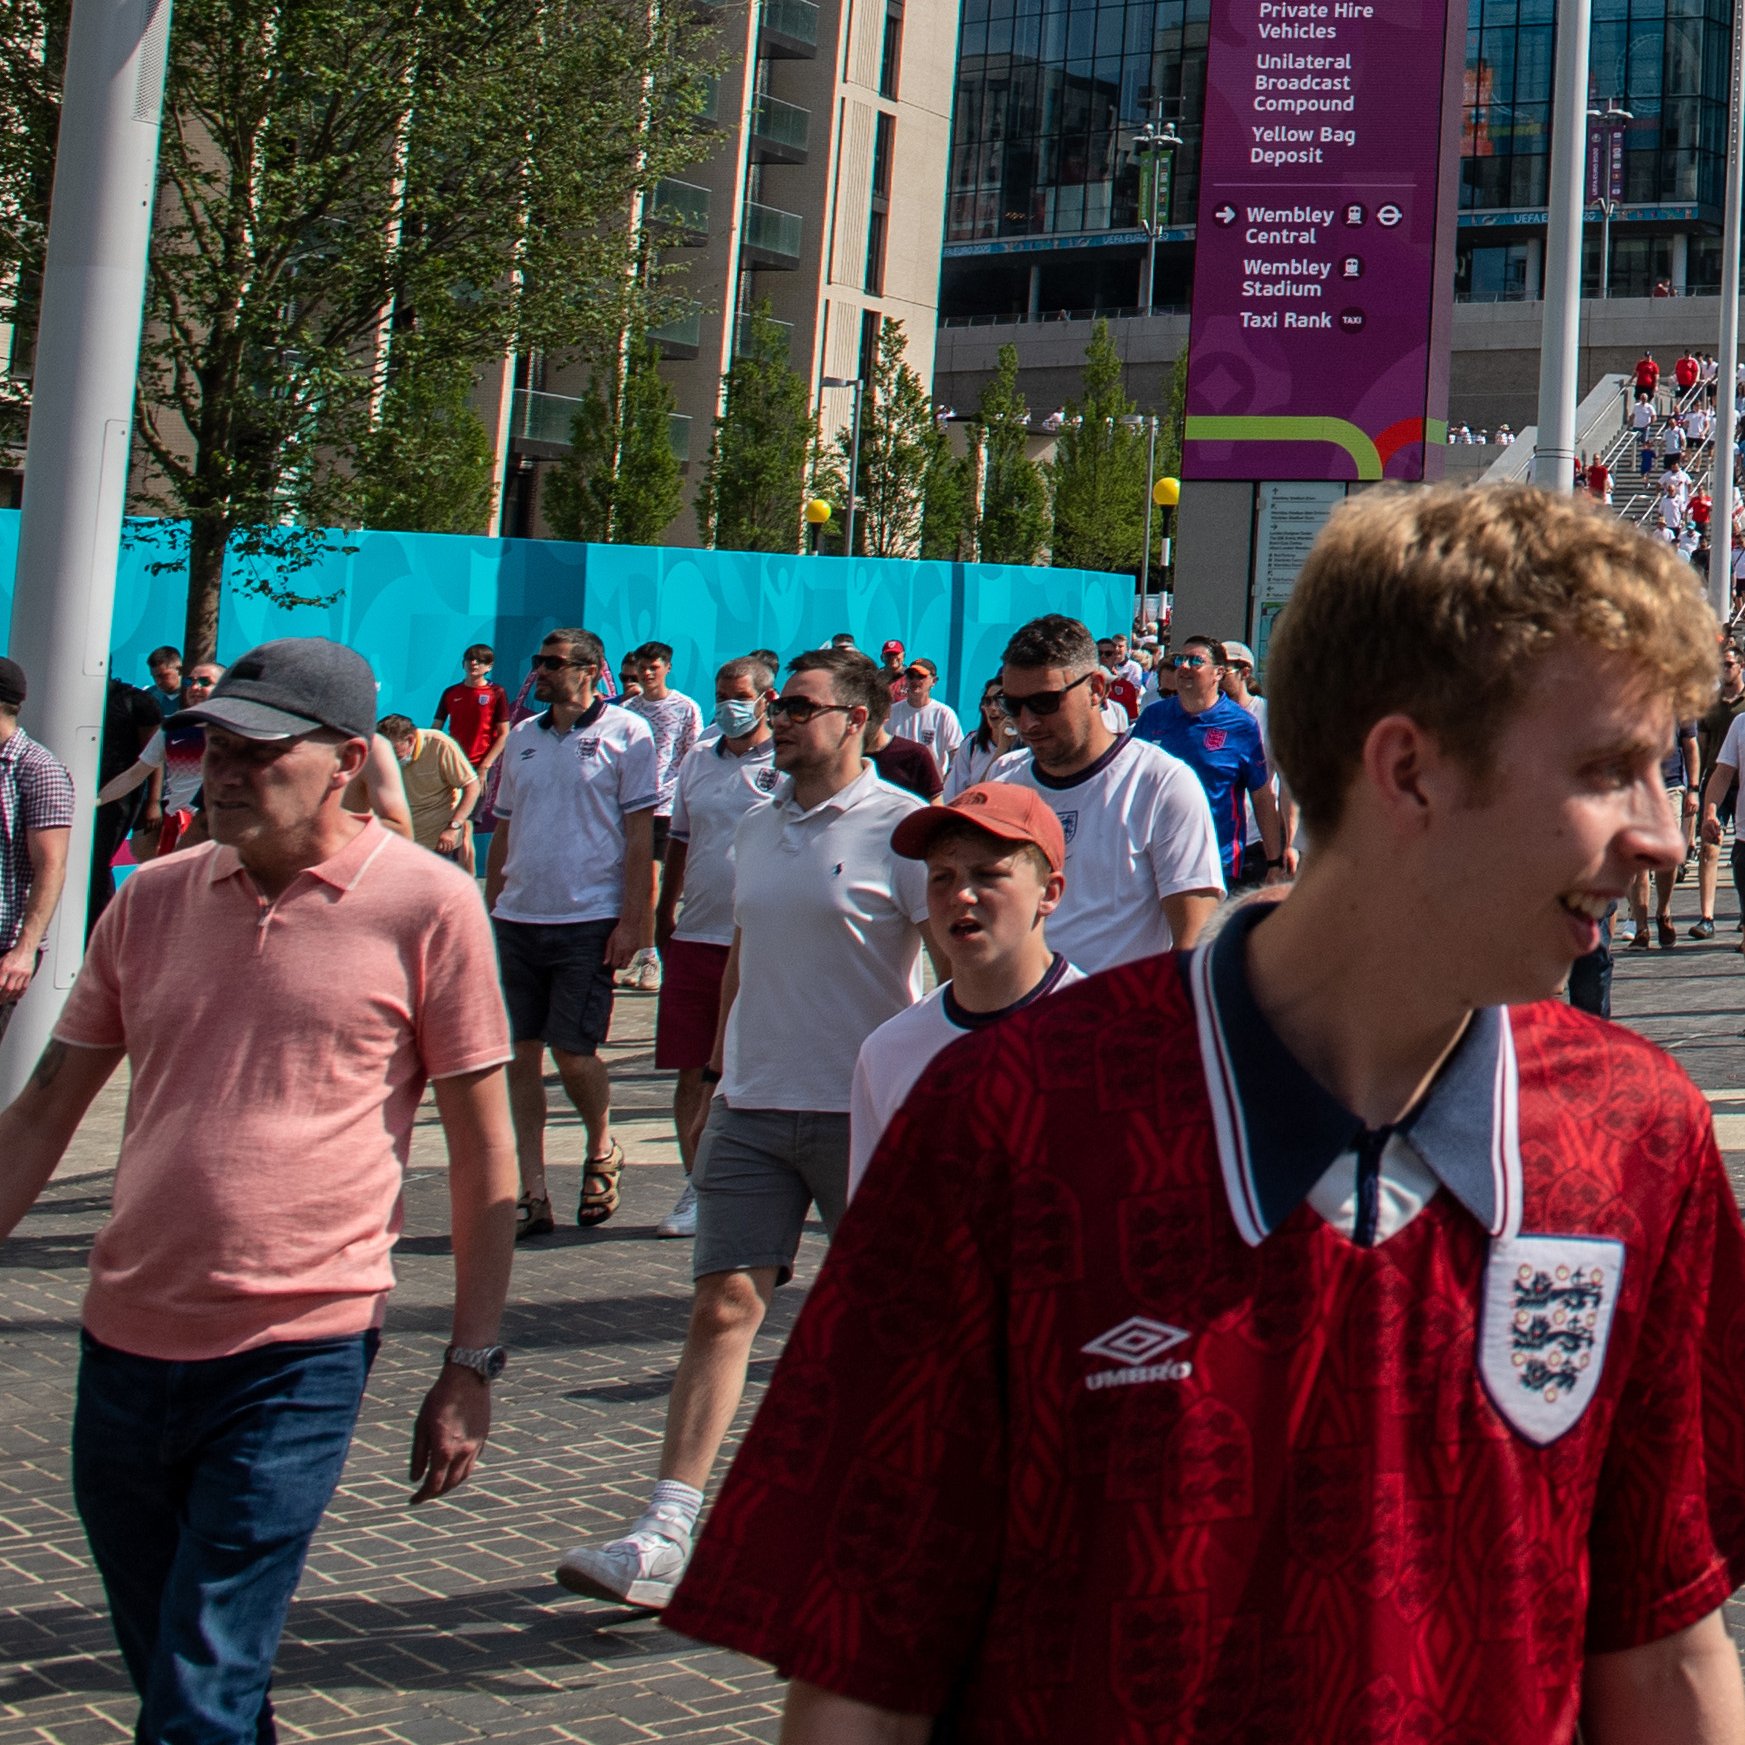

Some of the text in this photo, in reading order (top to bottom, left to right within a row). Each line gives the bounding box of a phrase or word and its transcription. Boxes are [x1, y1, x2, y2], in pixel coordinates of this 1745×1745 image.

[1260, 2, 1373, 17] Private Hire
[1259, 23, 1336, 38] Vehicles
[1257, 53, 1351, 69] Unilateral
[1256, 75, 1350, 90] Broadcast
[1254, 96, 1354, 115] Compound
[1252, 126, 1355, 146] Yellow Bag
[1251, 147, 1322, 166] Deposit
[1247, 207, 1334, 226] Wembley
[1246, 228, 1316, 243] Central
[1244, 259, 1331, 279] Wembley
[1242, 280, 1320, 296] Stadium
[1240, 312, 1277, 327] Taxi
[1285, 312, 1331, 327] Rank
[1087, 1358, 1193, 1389] UMBRO
